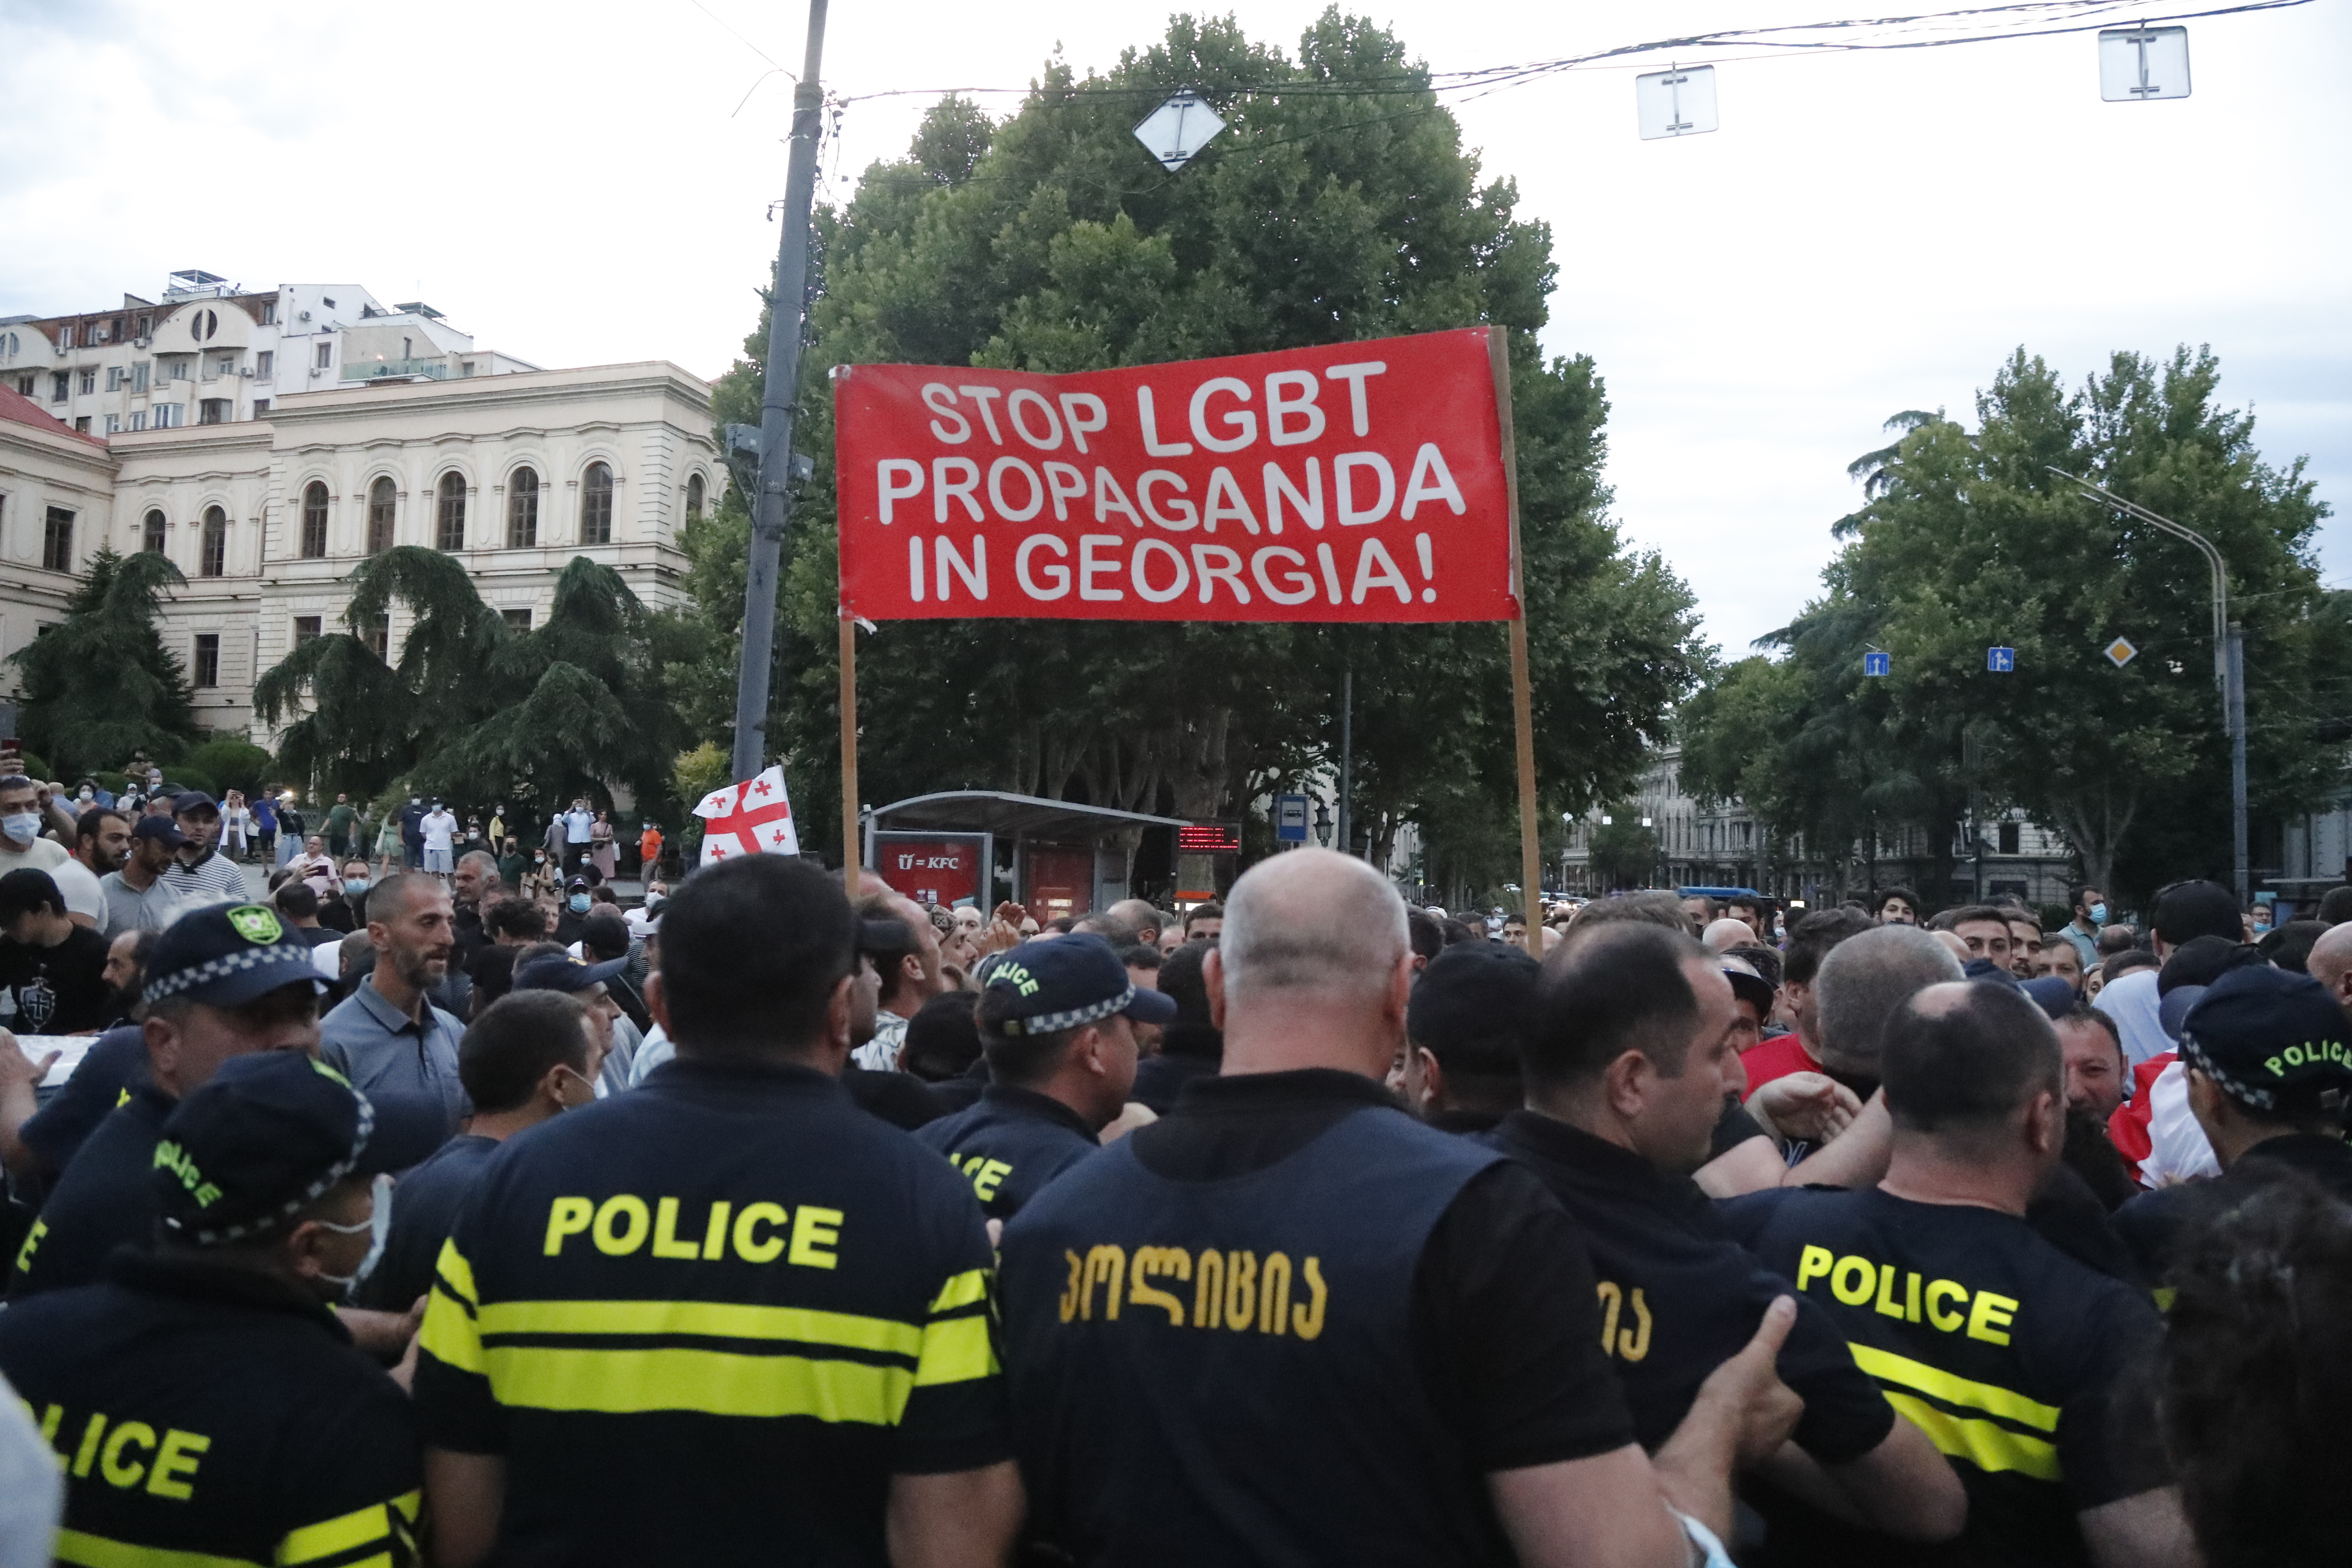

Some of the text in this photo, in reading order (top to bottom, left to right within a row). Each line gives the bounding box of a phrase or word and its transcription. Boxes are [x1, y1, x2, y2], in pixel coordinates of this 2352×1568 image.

[920, 360, 1388, 458] STOP LGBT
[877, 442, 1467, 536] PROPAGANDA
[908, 532, 1437, 605] IN GEORGIA!
[927, 857, 959, 869] KFC
[543, 1194, 844, 1270] POLICE
[1796, 1244, 2020, 1347] POLICE
